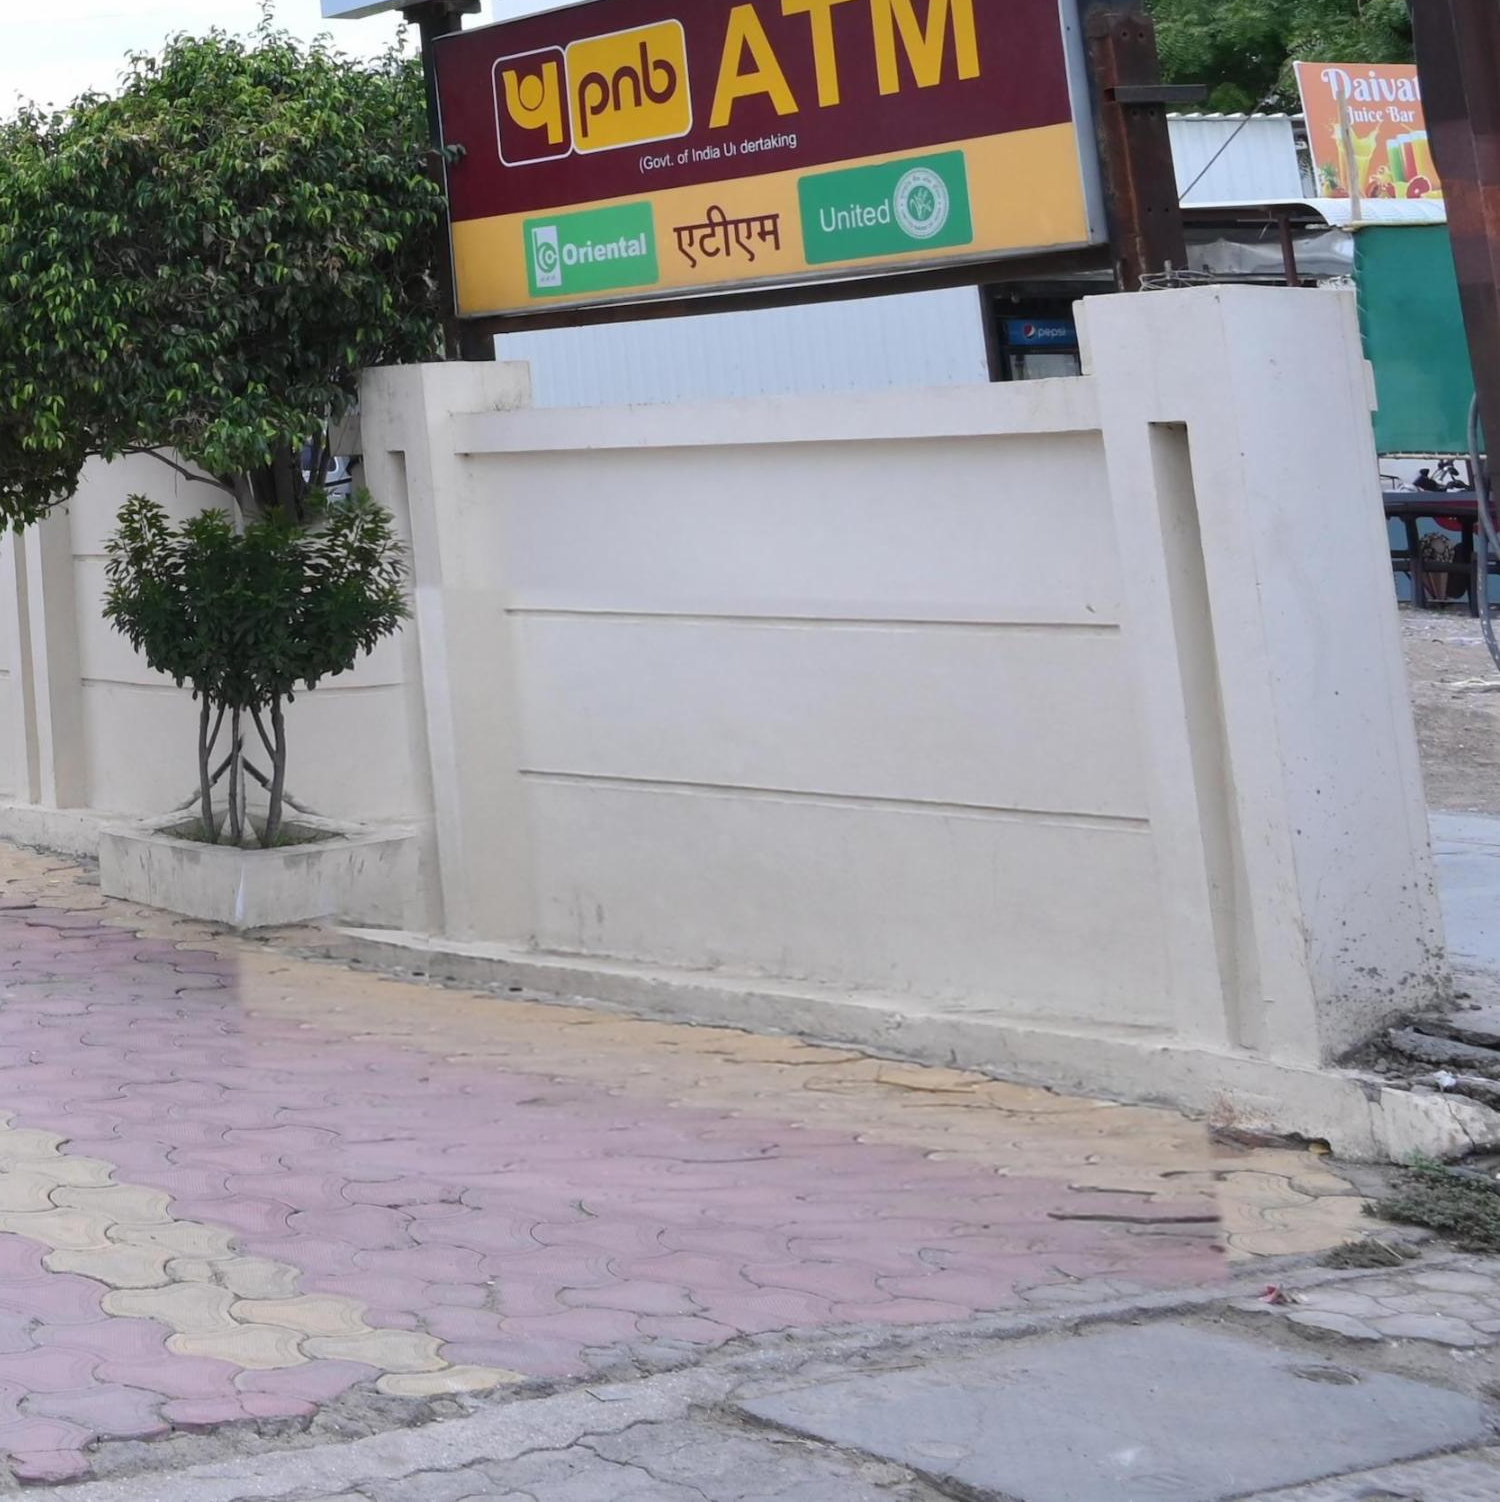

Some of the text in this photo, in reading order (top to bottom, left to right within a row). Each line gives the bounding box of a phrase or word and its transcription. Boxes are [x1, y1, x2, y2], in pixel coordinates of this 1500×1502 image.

[577, 41, 677, 138] pnb
[1346, 105, 1415, 125] Juice Bar
[639, 155, 674, 174] (Govt.
[677, 149, 689, 165] of
[692, 146, 720, 162] India
[819, 197, 891, 231] United
[562, 232, 647, 266] Oriental
[673, 205, 780, 268] एटीएम
[1038, 327, 1066, 338] pepsi
